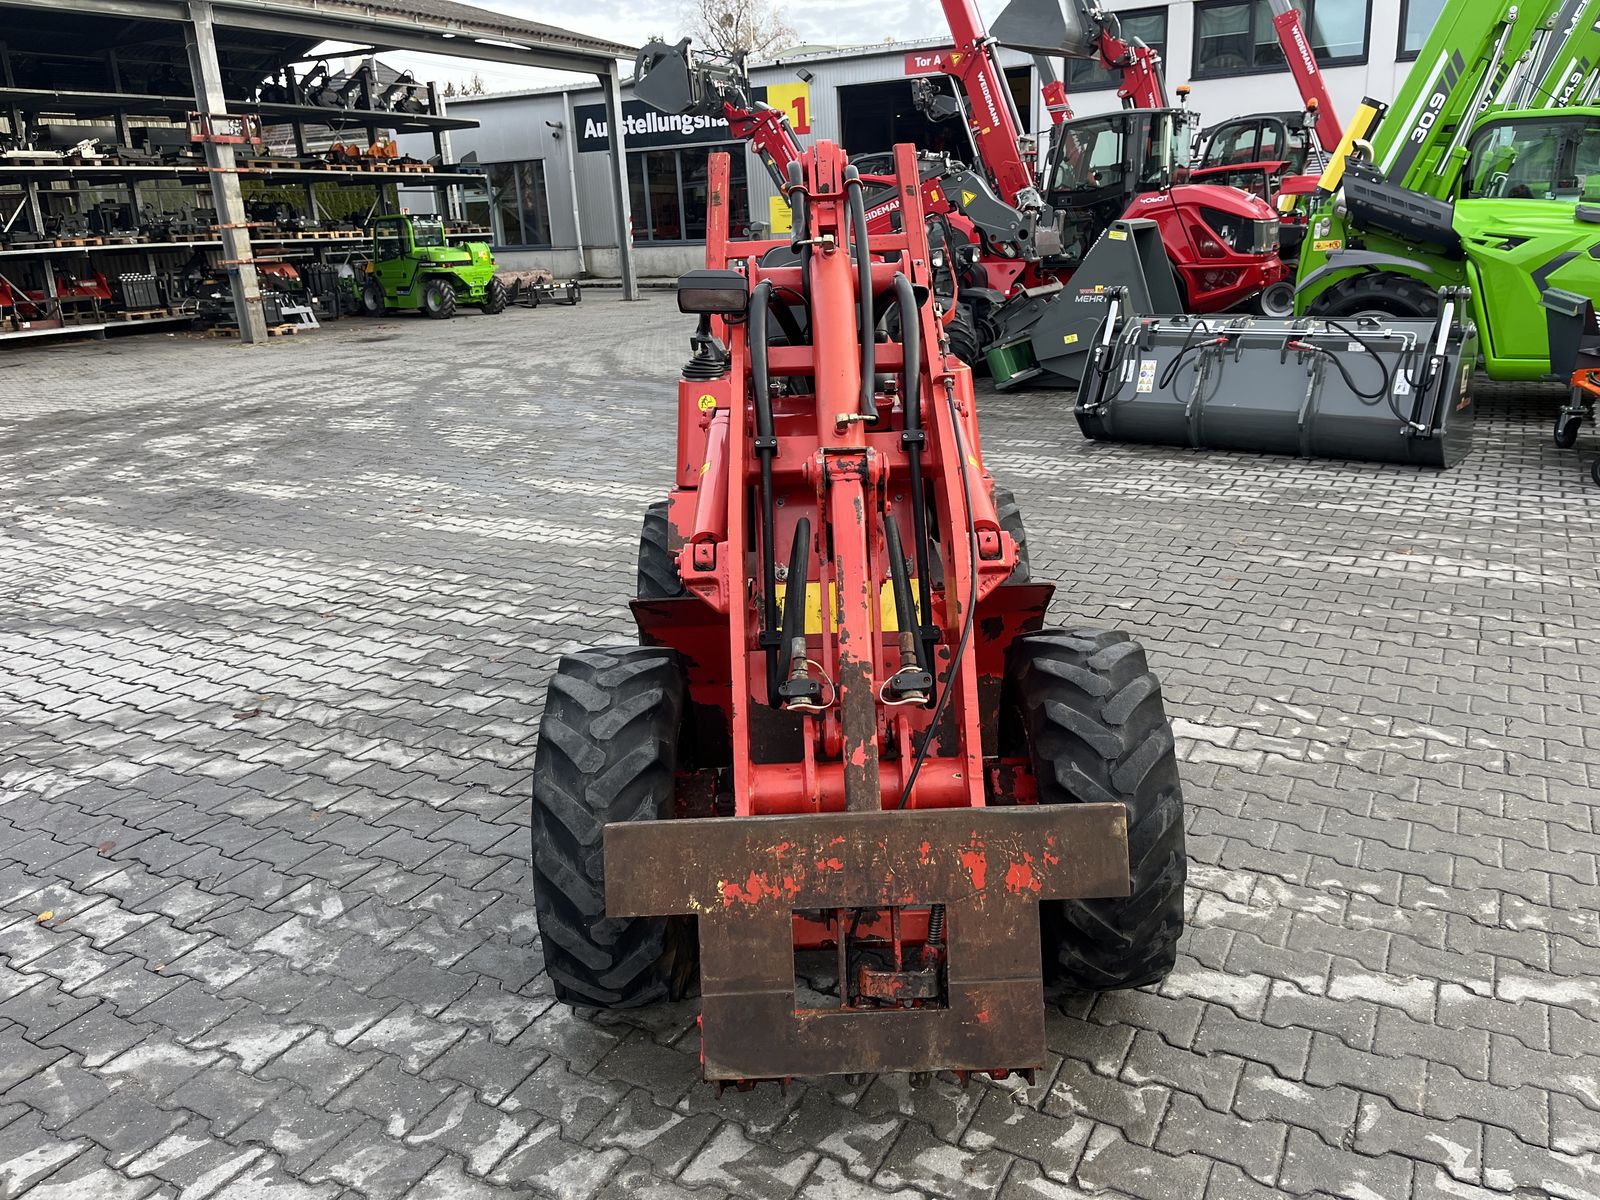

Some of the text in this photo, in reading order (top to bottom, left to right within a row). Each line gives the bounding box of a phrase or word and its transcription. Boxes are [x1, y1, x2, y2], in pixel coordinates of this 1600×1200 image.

[914, 54, 942, 68] Tor A
[1291, 24, 1316, 76] WEIDEMANN
[791, 96, 811, 136] 1
[977, 71, 1001, 128] WEIDEMANN
[1410, 92, 1447, 144] 30.9
[1478, 89, 1494, 113] 0.7
[864, 199, 900, 222] EIDEMAN
